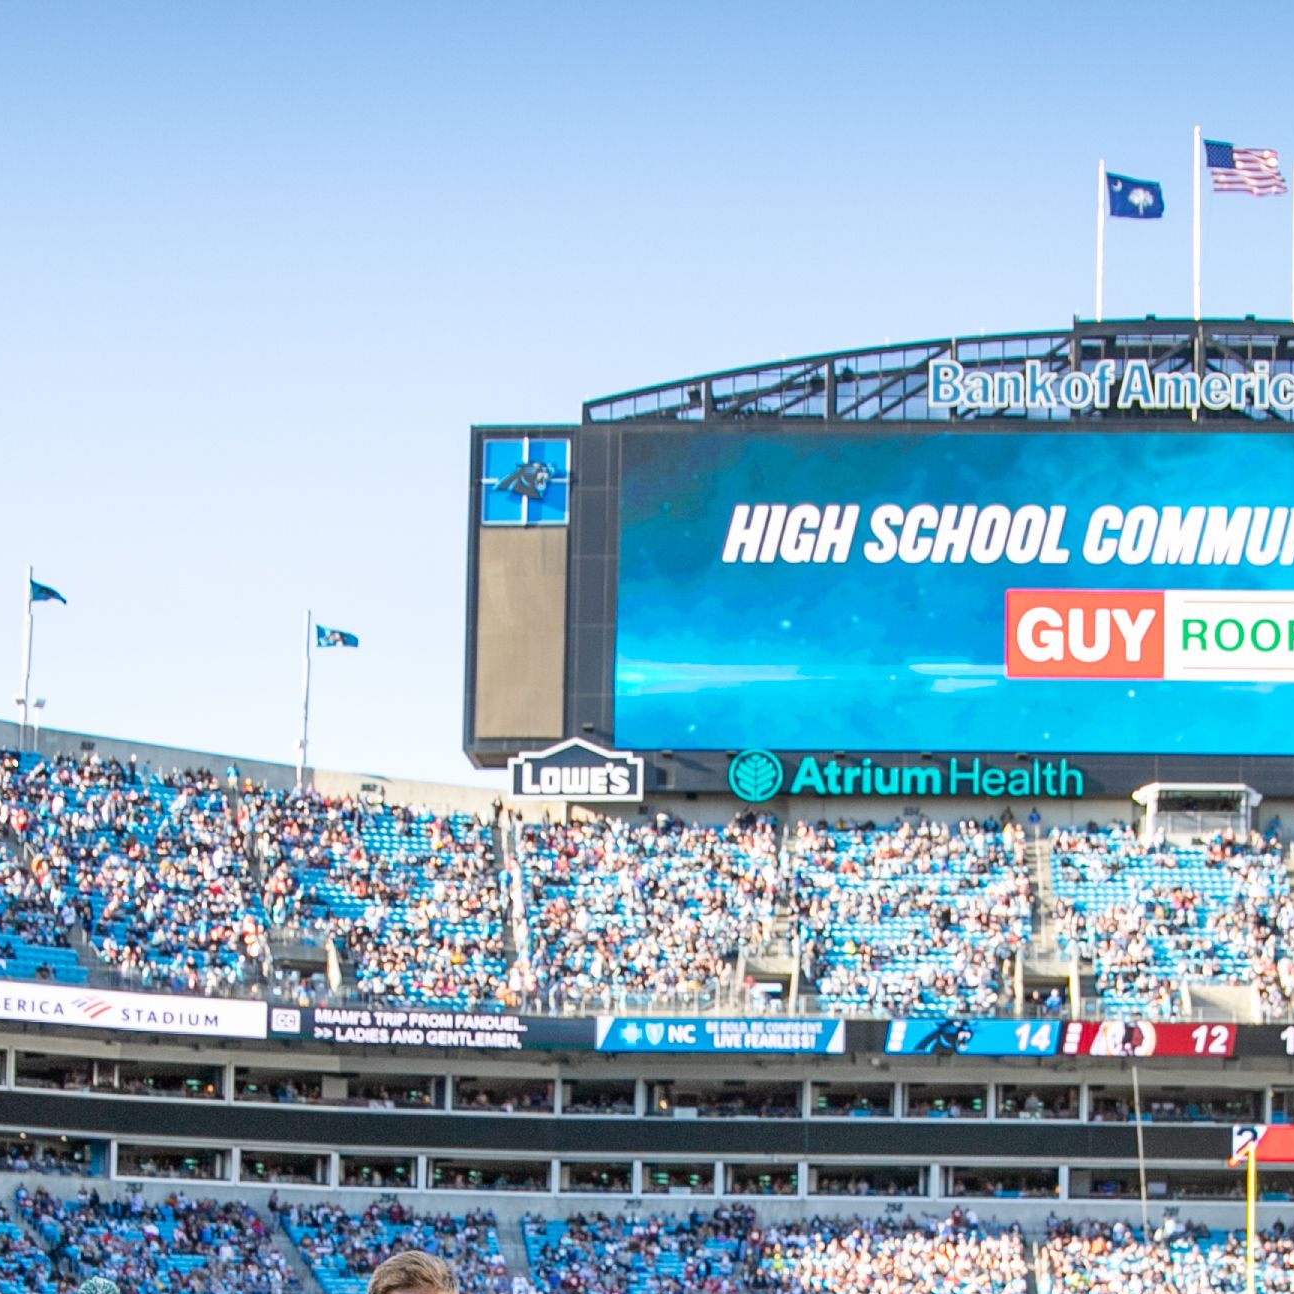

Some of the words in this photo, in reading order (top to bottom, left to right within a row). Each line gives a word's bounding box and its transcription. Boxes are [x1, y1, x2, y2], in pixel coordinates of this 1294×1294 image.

[928, 360, 1058, 409] Bank
[1061, 360, 1115, 409] of
[722, 504, 860, 564] HIGH
[864, 504, 1070, 565] SCHOOL
[1016, 606, 1157, 663] GUY
[521, 761, 630, 795] LOWE'S
[791, 757, 941, 796] Atrium
[949, 759, 1083, 797] Health
[121, 1008, 219, 1028] STADIUM
[314, 1009, 371, 1025] MIAMI'S
[373, 1011, 407, 1027] TRIP
[409, 1012, 453, 1029] FROM
[455, 1013, 527, 1032] FANDUEL.
[335, 1027, 389, 1044] LADIES
[390, 1029, 423, 1045] AND
[426, 1030, 522, 1049] GENTLEMEN,
[668, 1025, 696, 1044] NC
[713, 1034, 742, 1048] LIVE
[744, 1034, 816, 1050] FEARLESS!
[1015, 1023, 1052, 1051] 14
[1191, 1025, 1229, 1054] 12
